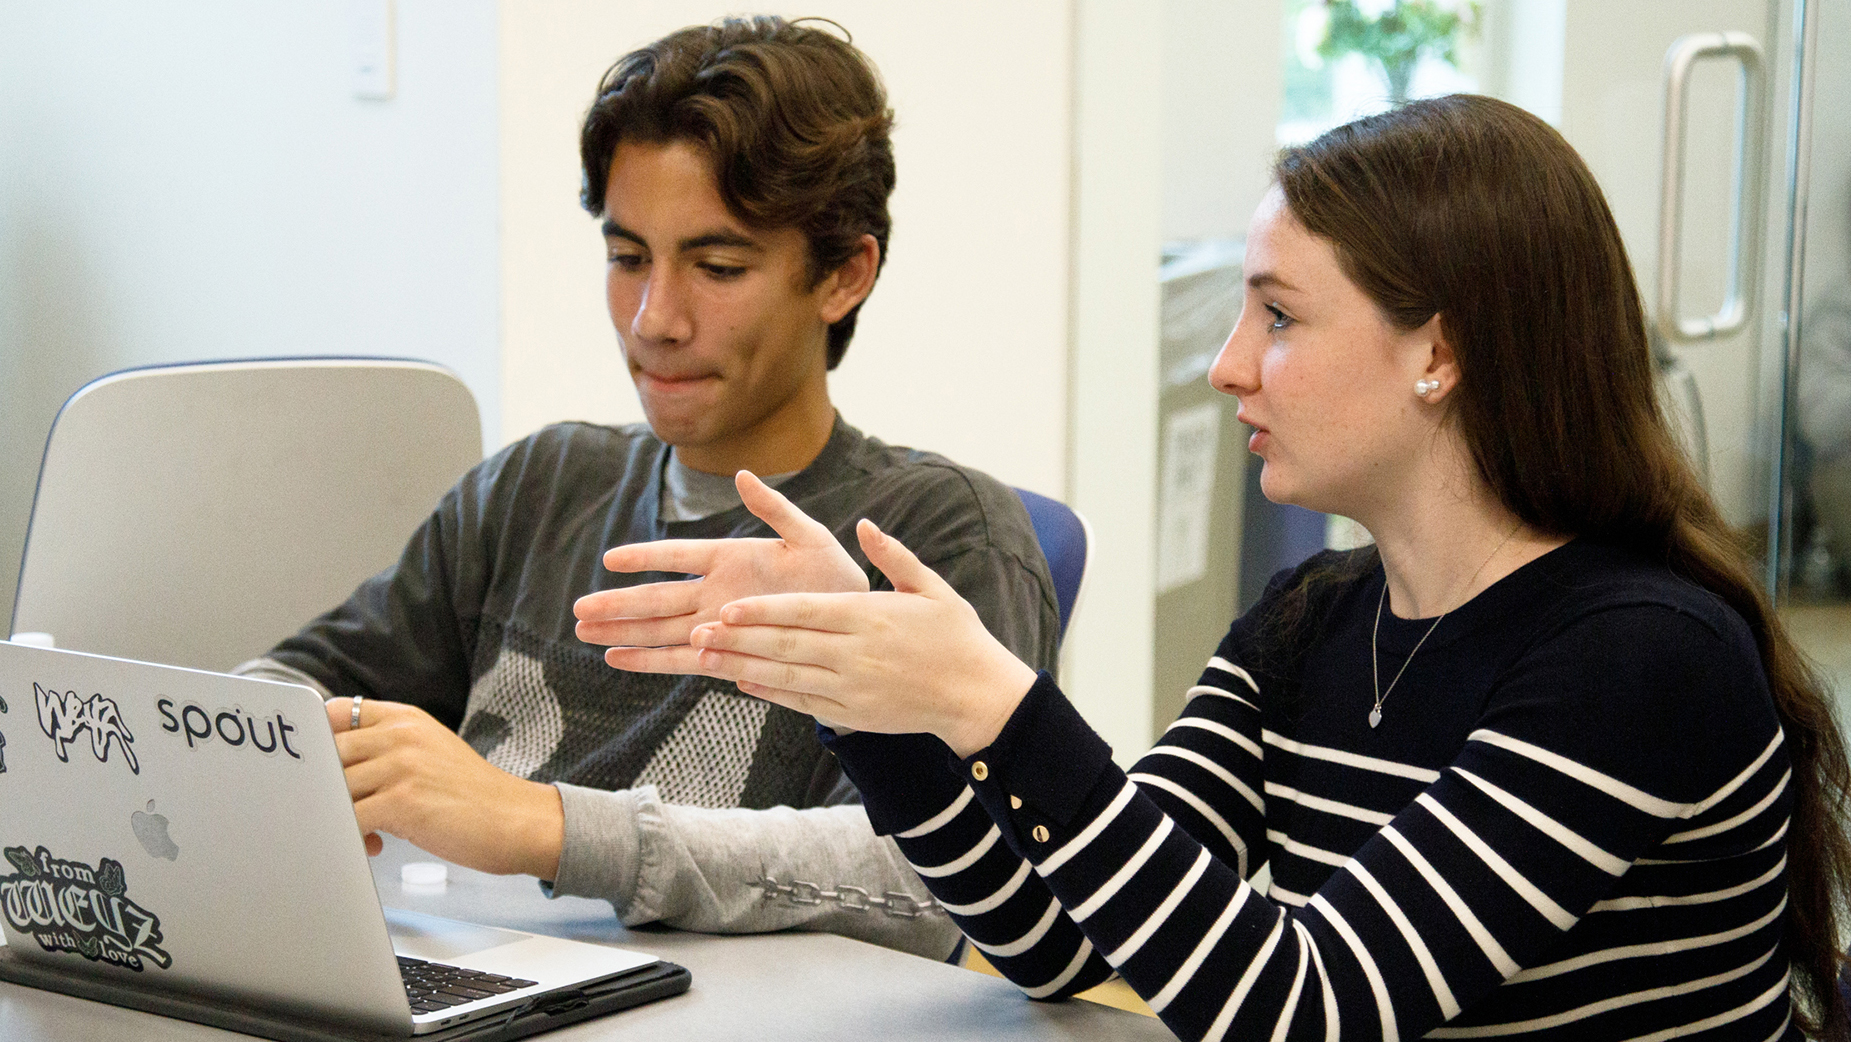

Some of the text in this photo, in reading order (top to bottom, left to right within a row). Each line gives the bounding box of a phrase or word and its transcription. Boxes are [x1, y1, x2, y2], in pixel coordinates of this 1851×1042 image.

[157, 699, 301, 759] spout
[39, 851, 96, 885] from
[38, 931, 140, 968] with love
